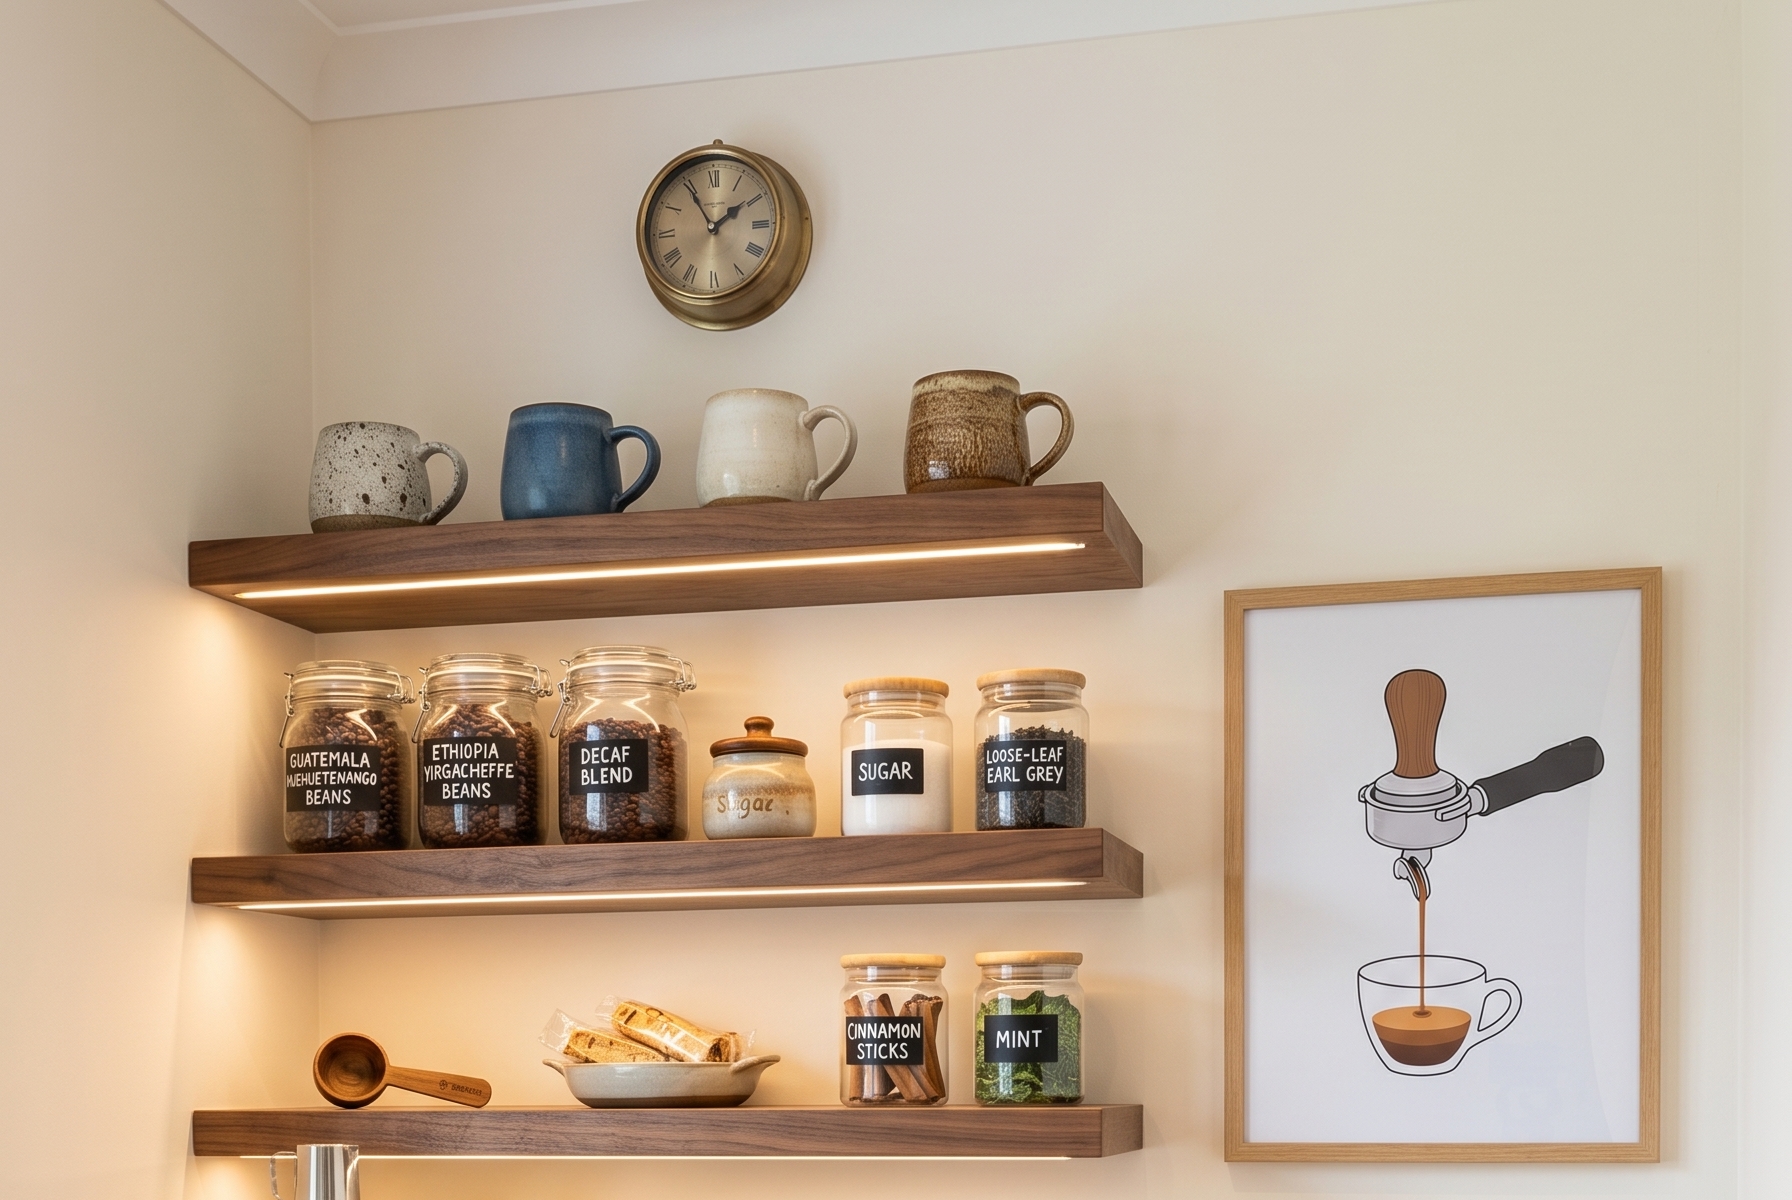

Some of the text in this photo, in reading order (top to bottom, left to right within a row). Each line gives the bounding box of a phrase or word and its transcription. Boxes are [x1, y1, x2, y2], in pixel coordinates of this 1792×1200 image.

[290, 752, 370, 768] GUATEMALA
[433, 743, 499, 760] ETHIOPIA
[581, 745, 630, 764] DECAF
[986, 746, 1064, 765] LOOSE-LEAF
[424, 763, 515, 783] YIRGACHEFFE
[582, 767, 632, 785] BLEND
[858, 762, 914, 781] SUGAR
[987, 766, 1064, 785] EARL GREY
[306, 789, 351, 805] BEANS
[443, 783, 490, 799] BEANS
[847, 1022, 921, 1041] CINNAMON
[996, 1030, 1042, 1048] MINT
[856, 1042, 909, 1060] STICKS
